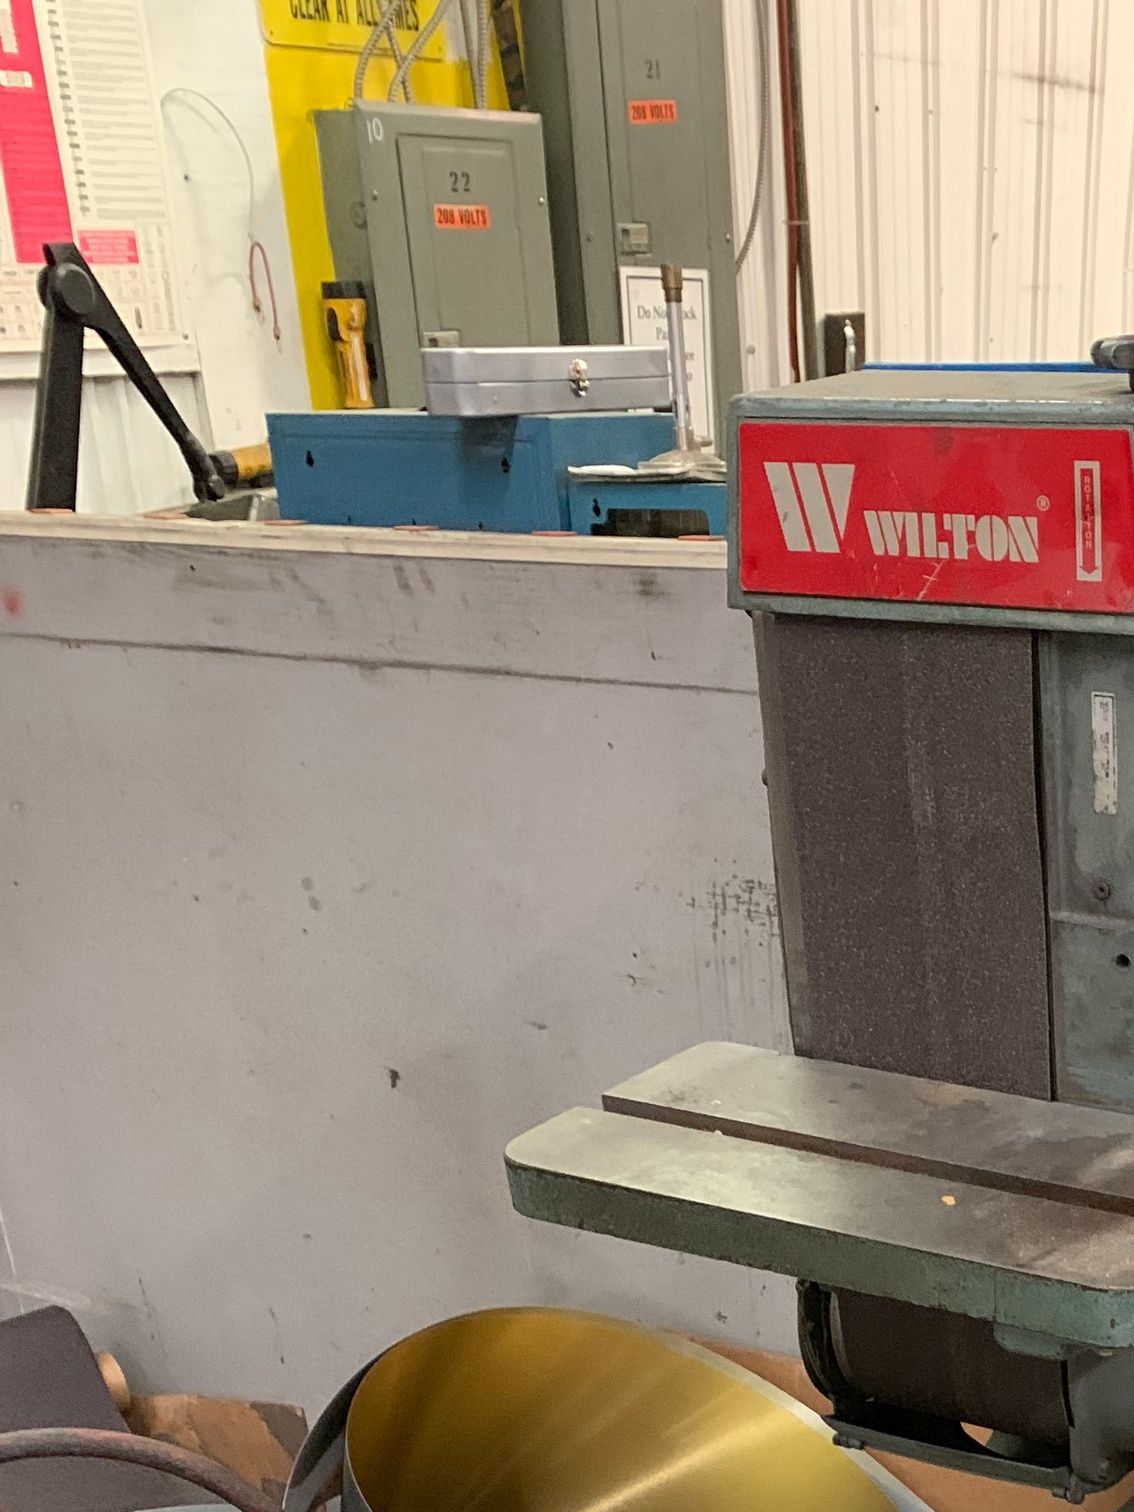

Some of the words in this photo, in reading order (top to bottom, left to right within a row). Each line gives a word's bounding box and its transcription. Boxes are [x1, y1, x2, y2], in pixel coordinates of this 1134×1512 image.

[644, 59, 660, 79] 21
[650, 103, 675, 120] VOLTS
[366, 118, 384, 143] 10
[449, 171, 471, 192] 22
[436, 207, 455, 225] 208
[458, 208, 487, 227] VOLTS
[1082, 475, 1093, 549] ROTATION
[863, 510, 1040, 563] WILTON
